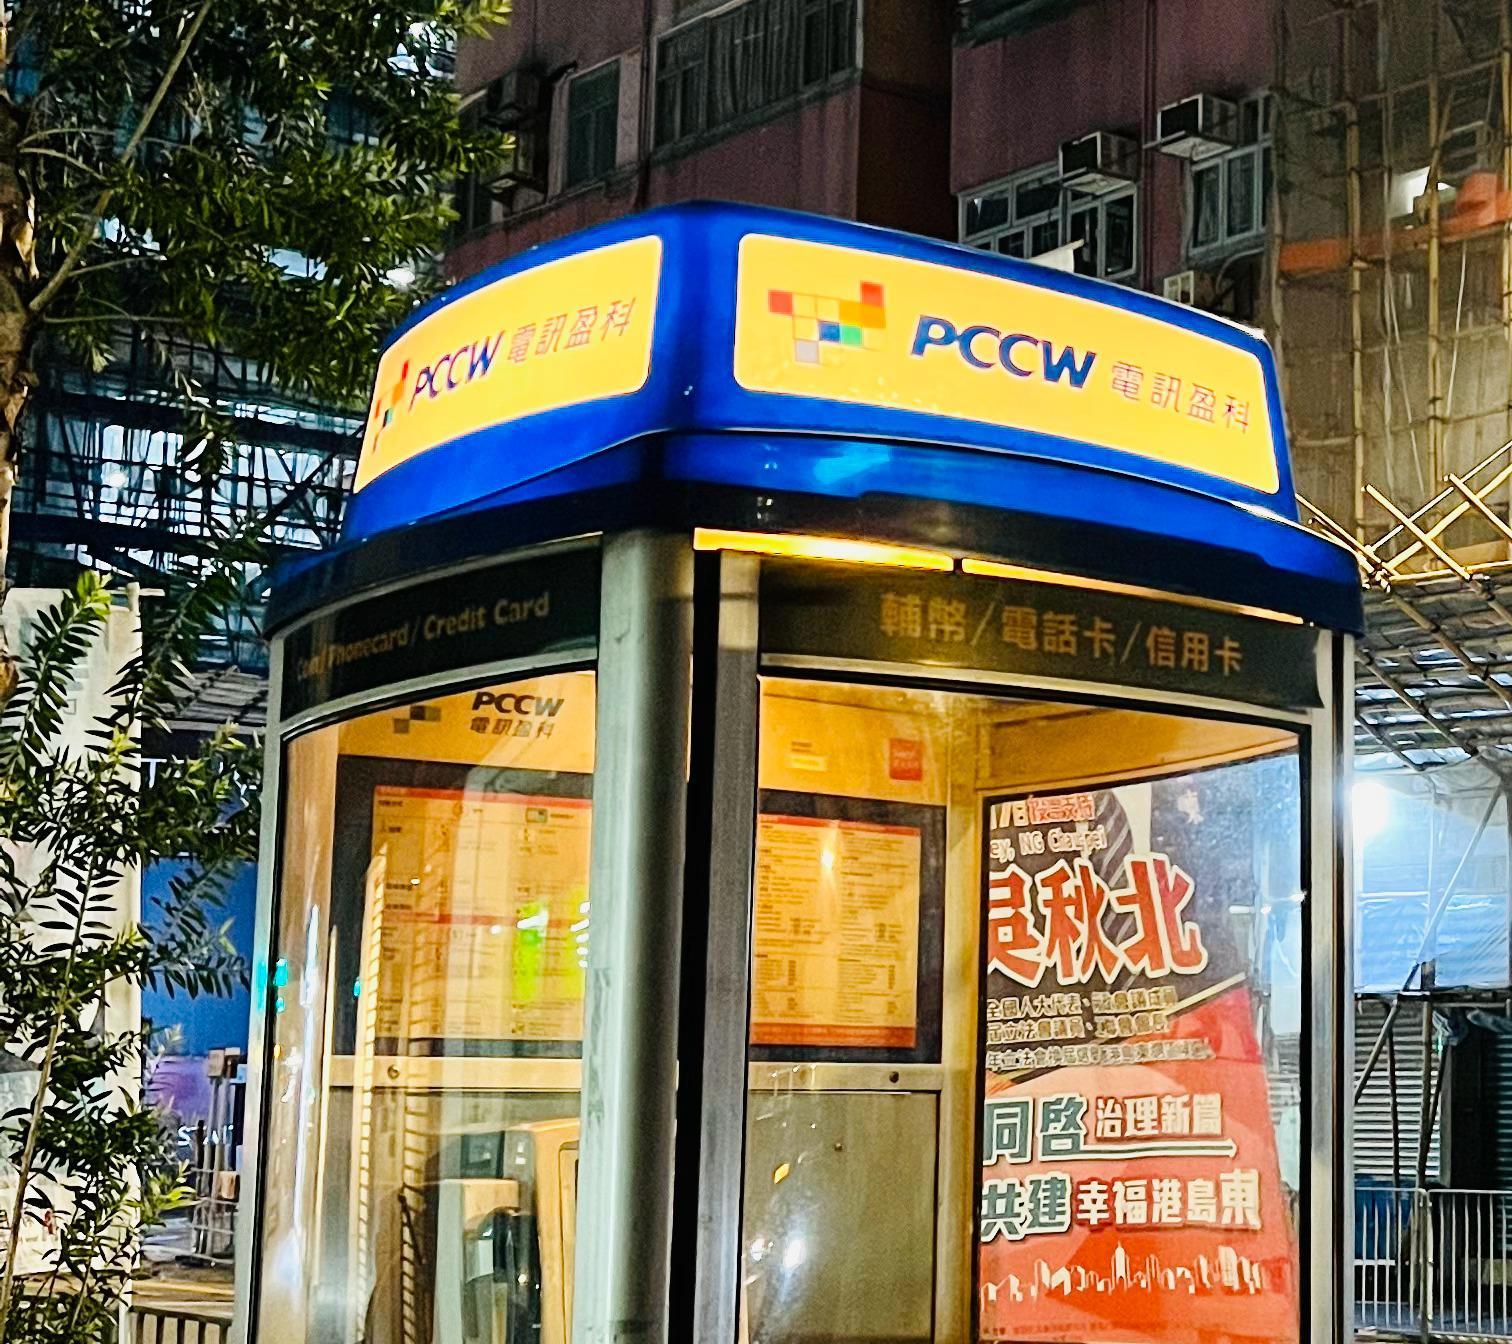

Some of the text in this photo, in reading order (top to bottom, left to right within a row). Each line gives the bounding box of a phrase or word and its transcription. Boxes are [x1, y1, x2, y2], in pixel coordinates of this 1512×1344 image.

[507, 297, 637, 364] 電訊盈科
[910, 314, 1097, 389] PCCW
[408, 329, 505, 413] PCCW
[1111, 360, 1250, 434] 電訊盈科
[471, 691, 566, 718] PCCW
